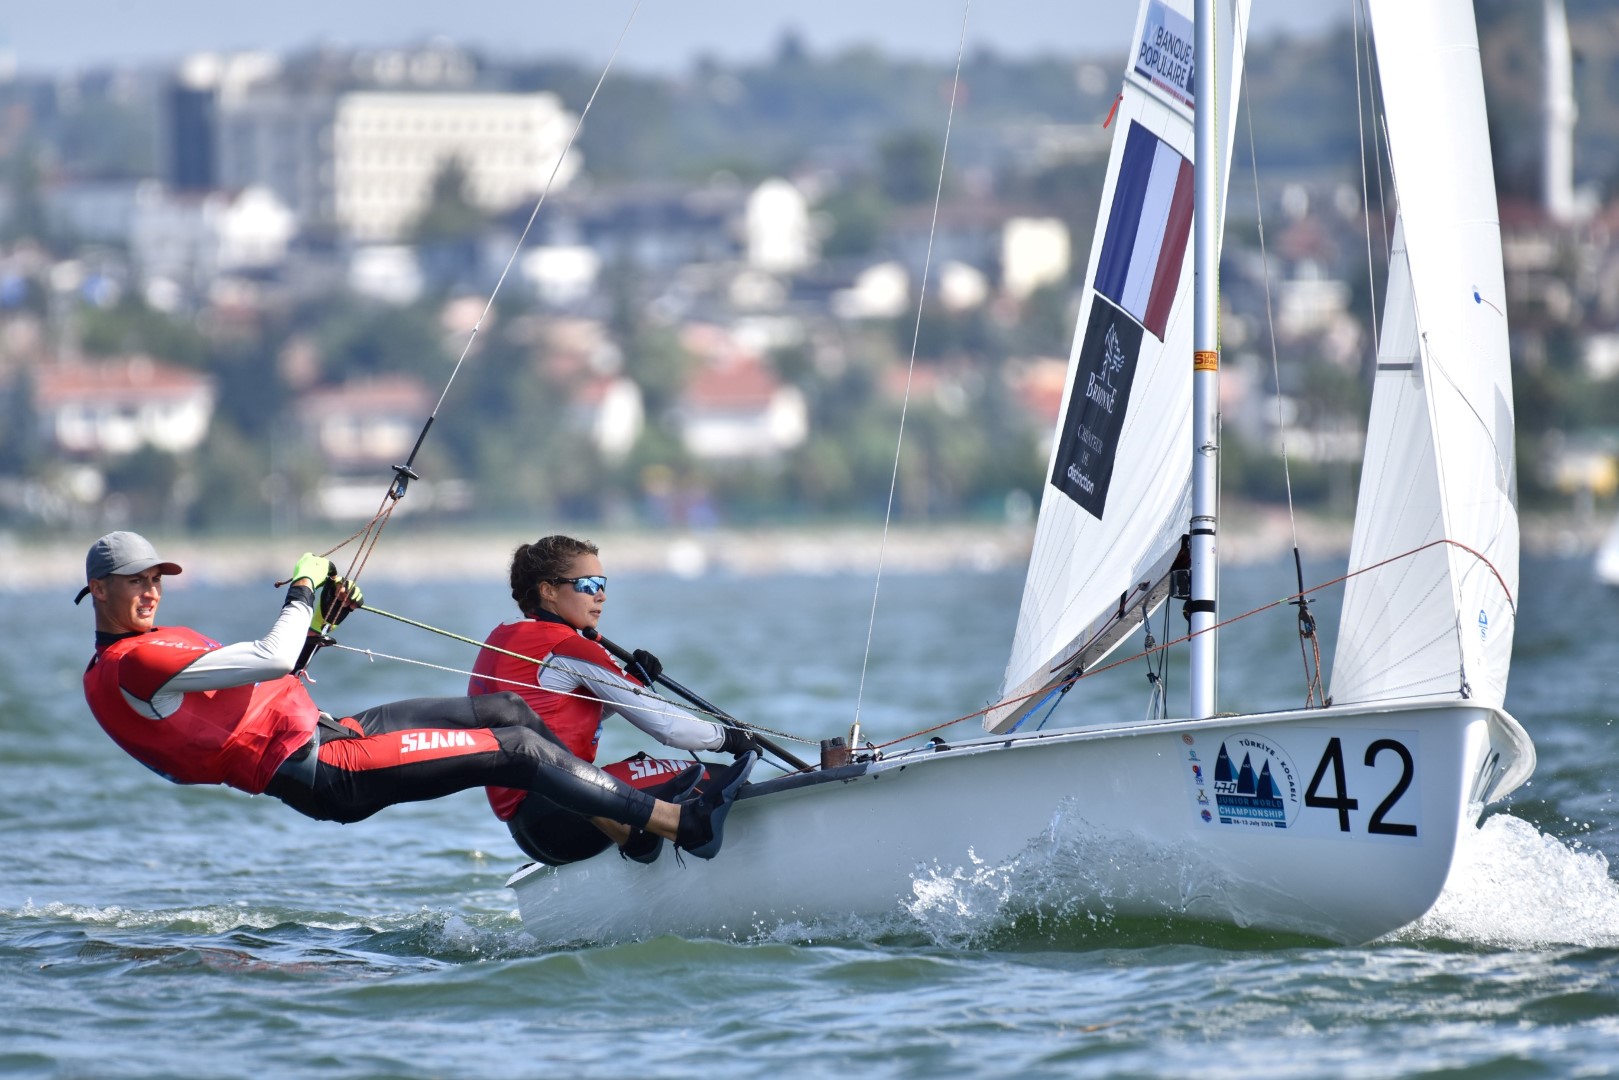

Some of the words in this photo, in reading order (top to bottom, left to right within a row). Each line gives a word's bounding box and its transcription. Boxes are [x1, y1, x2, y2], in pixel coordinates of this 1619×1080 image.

[1156, 26, 1192, 65] BANQUE
[1139, 41, 1187, 88] POPULAIRE
[1068, 463, 1094, 495] distinction
[400, 731, 476, 753] SLAM
[1214, 782, 1237, 794] 470
[1305, 737, 1417, 837] 42
[1218, 796, 1249, 805] JUNIOR
[1253, 798, 1282, 808] WORLD
[1220, 806, 1284, 819] CHAMPIONSHIP
